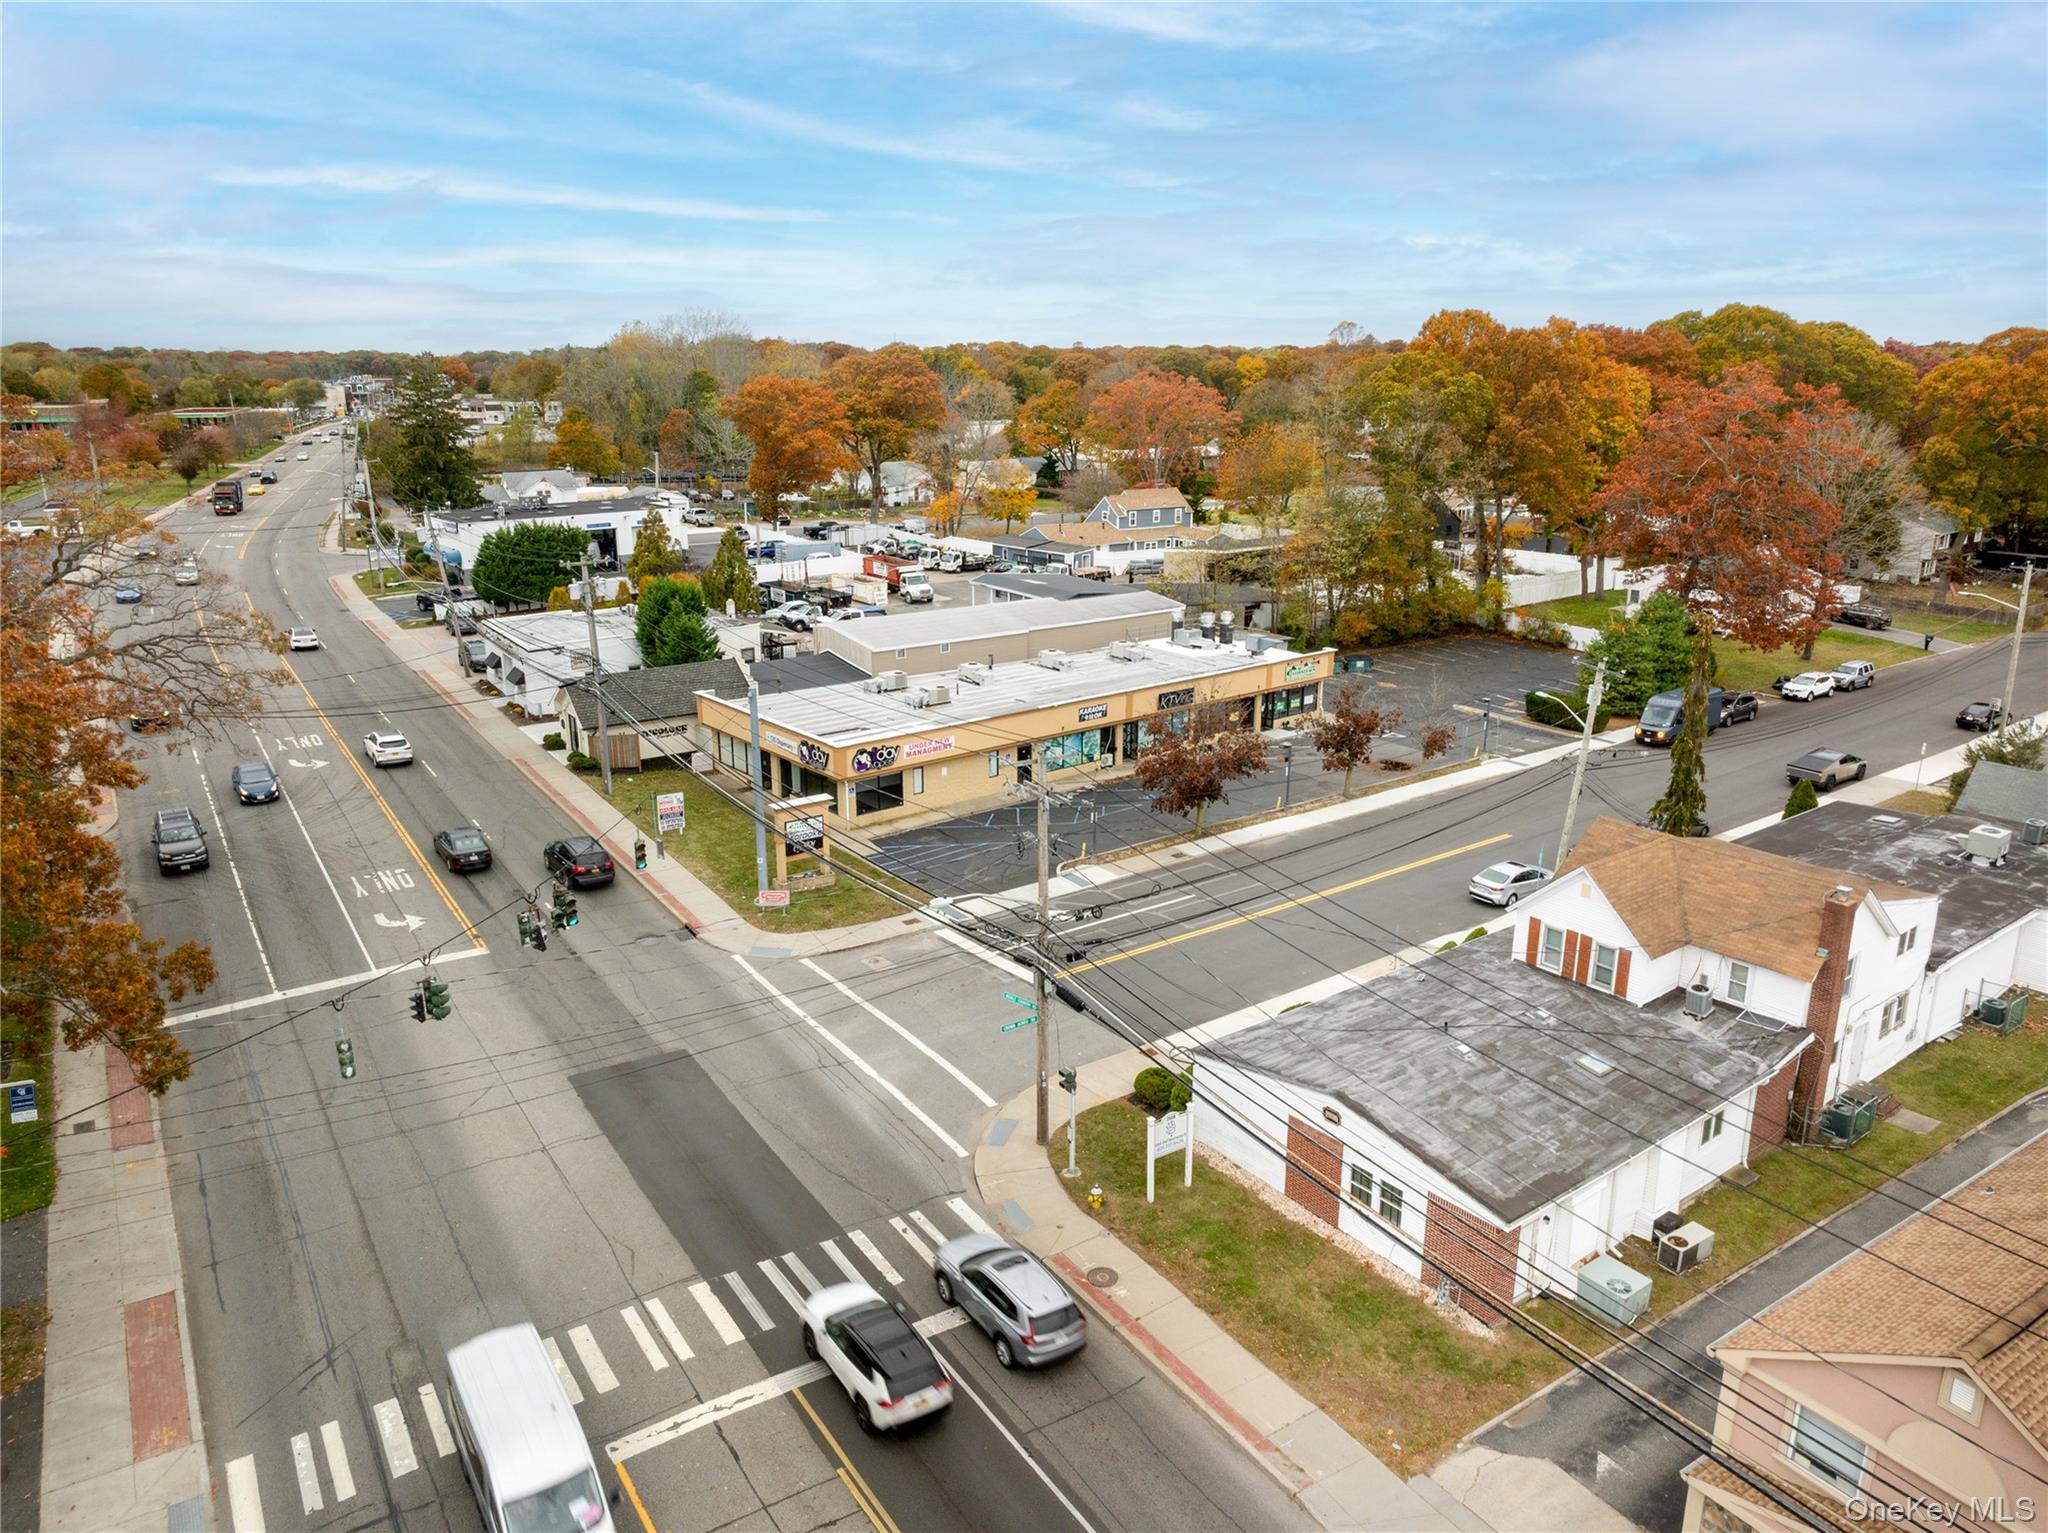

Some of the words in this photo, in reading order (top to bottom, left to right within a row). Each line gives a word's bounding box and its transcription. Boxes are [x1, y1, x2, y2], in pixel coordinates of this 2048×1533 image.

[276, 734, 323, 751] ONLY
[906, 743, 952, 757] MANAGMENT
[909, 740, 933, 750] UNDER
[351, 868, 415, 898] ONLY
